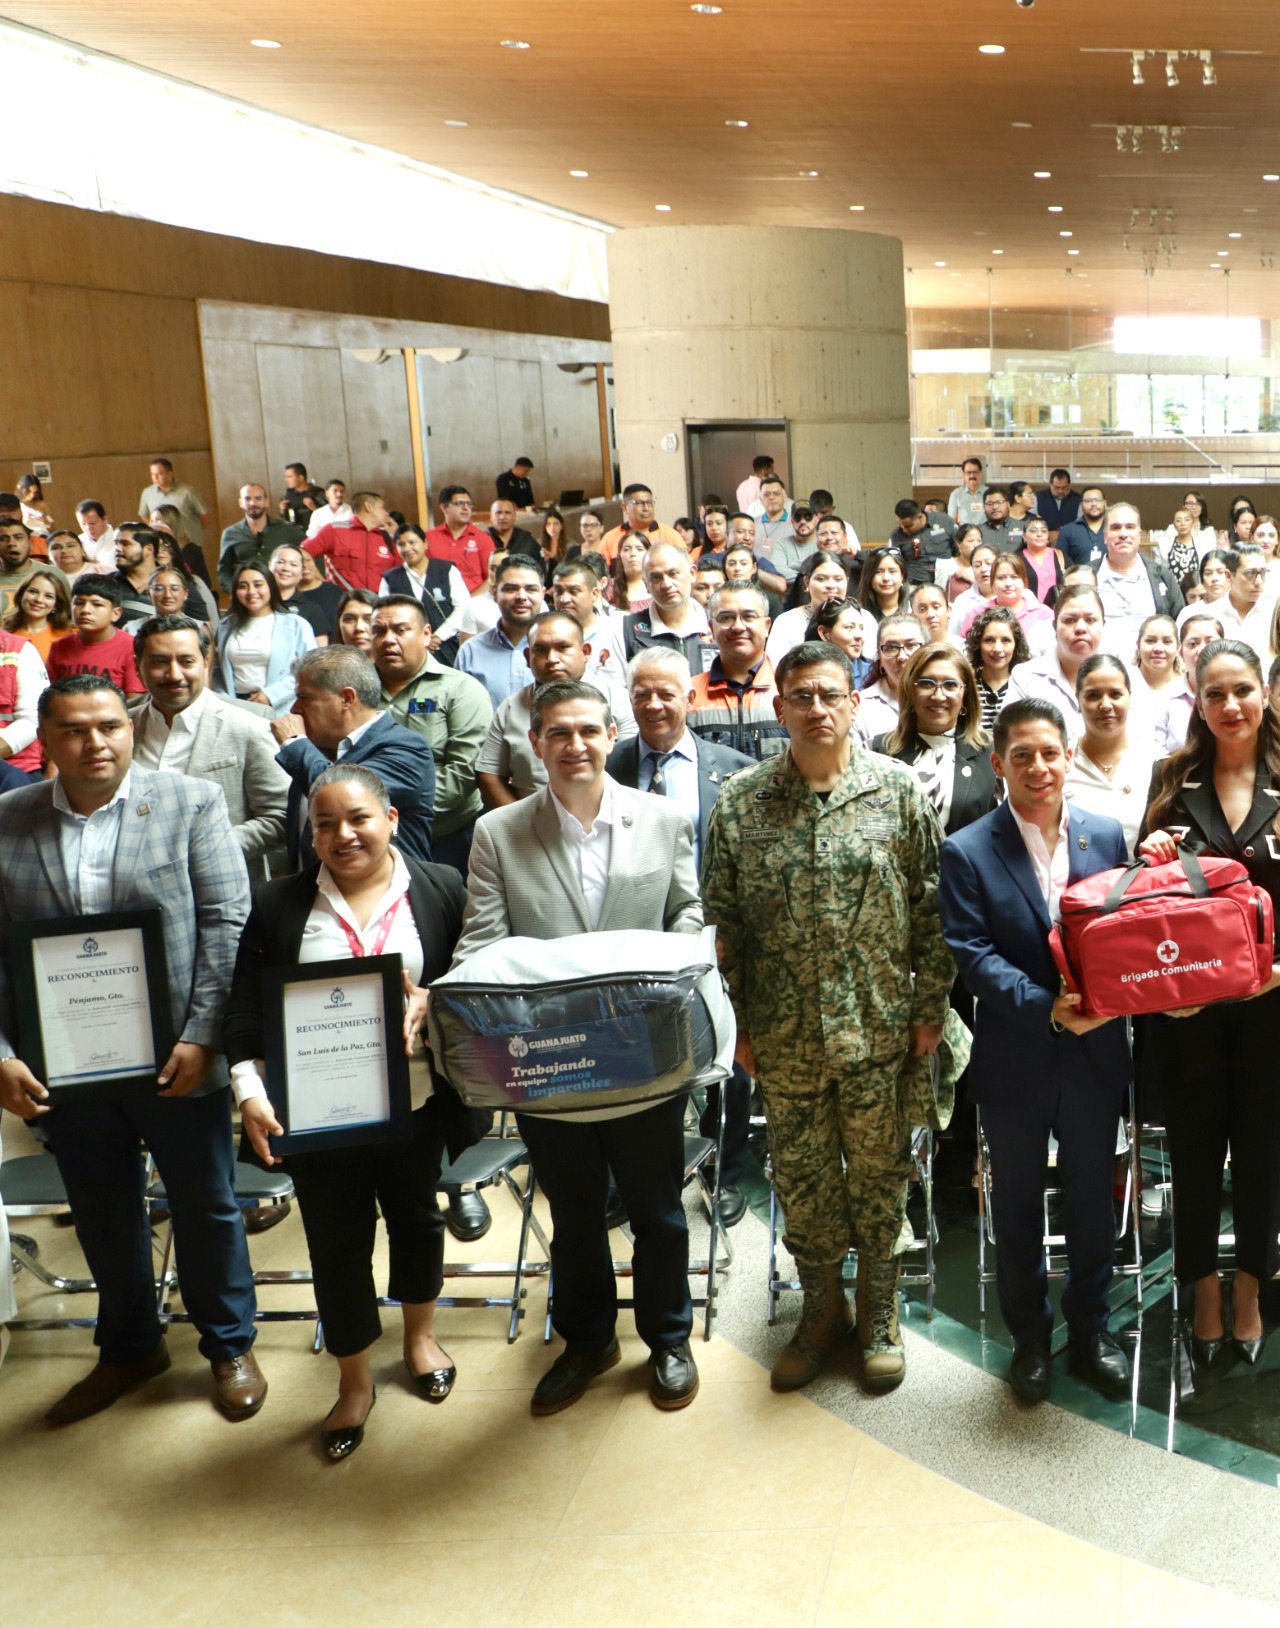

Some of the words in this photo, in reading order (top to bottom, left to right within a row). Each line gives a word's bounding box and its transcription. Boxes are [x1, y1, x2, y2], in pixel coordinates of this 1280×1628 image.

[47, 965, 140, 983] RECONOCIMIENTO
[1121, 969, 1160, 983] Brigada
[1161, 958, 1223, 976] Comunitaria
[69, 995, 107, 1005] Pénjamo,
[296, 1017, 381, 1034] RECONOCIMIENTO
[297, 1049, 312, 1057] San
[313, 1047, 330, 1055] Luis
[350, 1043, 365, 1051] Paz,
[366, 1041, 382, 1049] Gto.
[528, 1033, 587, 1050] GUANAJUATO
[511, 1057, 596, 1078] Trabajando
[517, 1078, 548, 1088] equipo
[550, 1071, 591, 1083] somos
[528, 1078, 611, 1098] imparables
